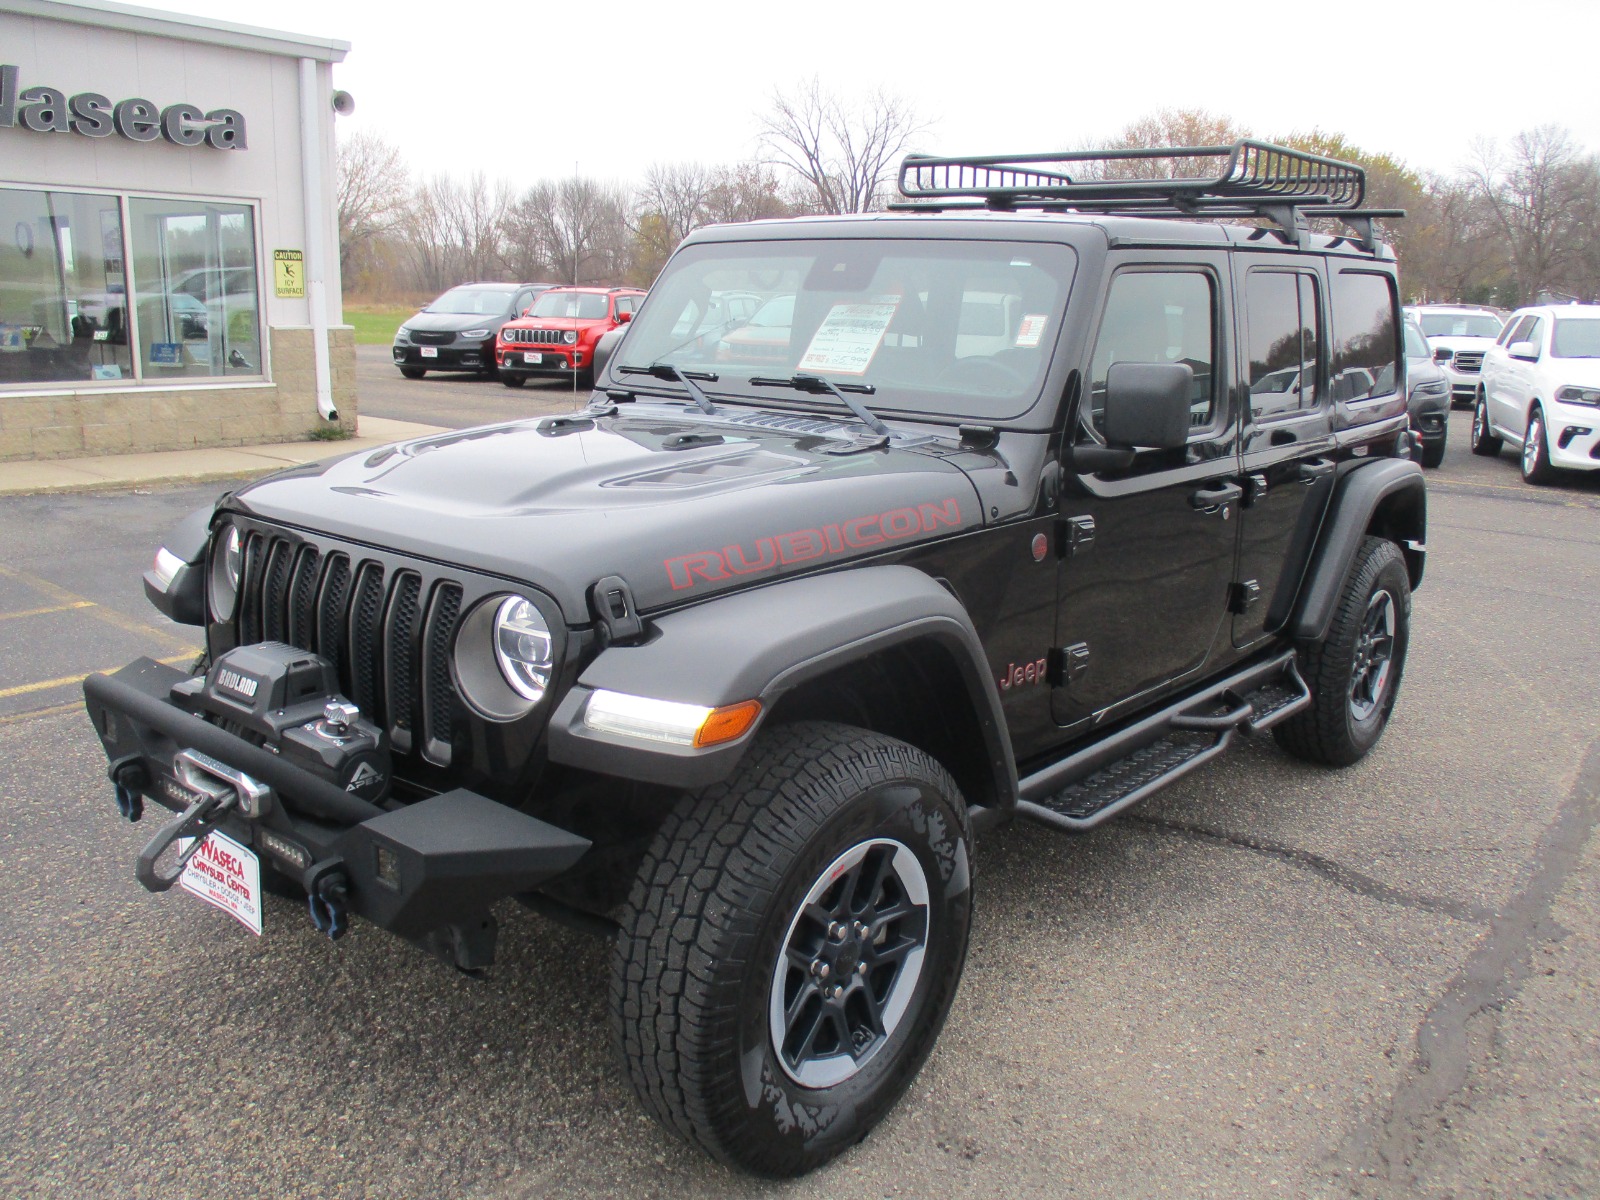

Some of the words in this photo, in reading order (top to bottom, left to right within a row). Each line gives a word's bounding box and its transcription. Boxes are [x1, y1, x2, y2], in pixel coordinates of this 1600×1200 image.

[274, 251, 302, 260] CAUTION
[277, 287, 303, 295] SURFACE
[284, 279, 295, 287] ICY
[663, 498, 962, 590] RUBICON
[218, 668, 258, 697] BADLAND
[1000, 658, 1047, 690] Jeep
[345, 773, 384, 792] APEX
[200, 838, 245, 880] WASECA
[187, 868, 217, 891] CHRYSLER
[220, 886, 240, 905] DODGE
[242, 903, 256, 915] JEEP
[192, 855, 226, 885] CHRYSLER
[226, 874, 251, 902] CENTER
